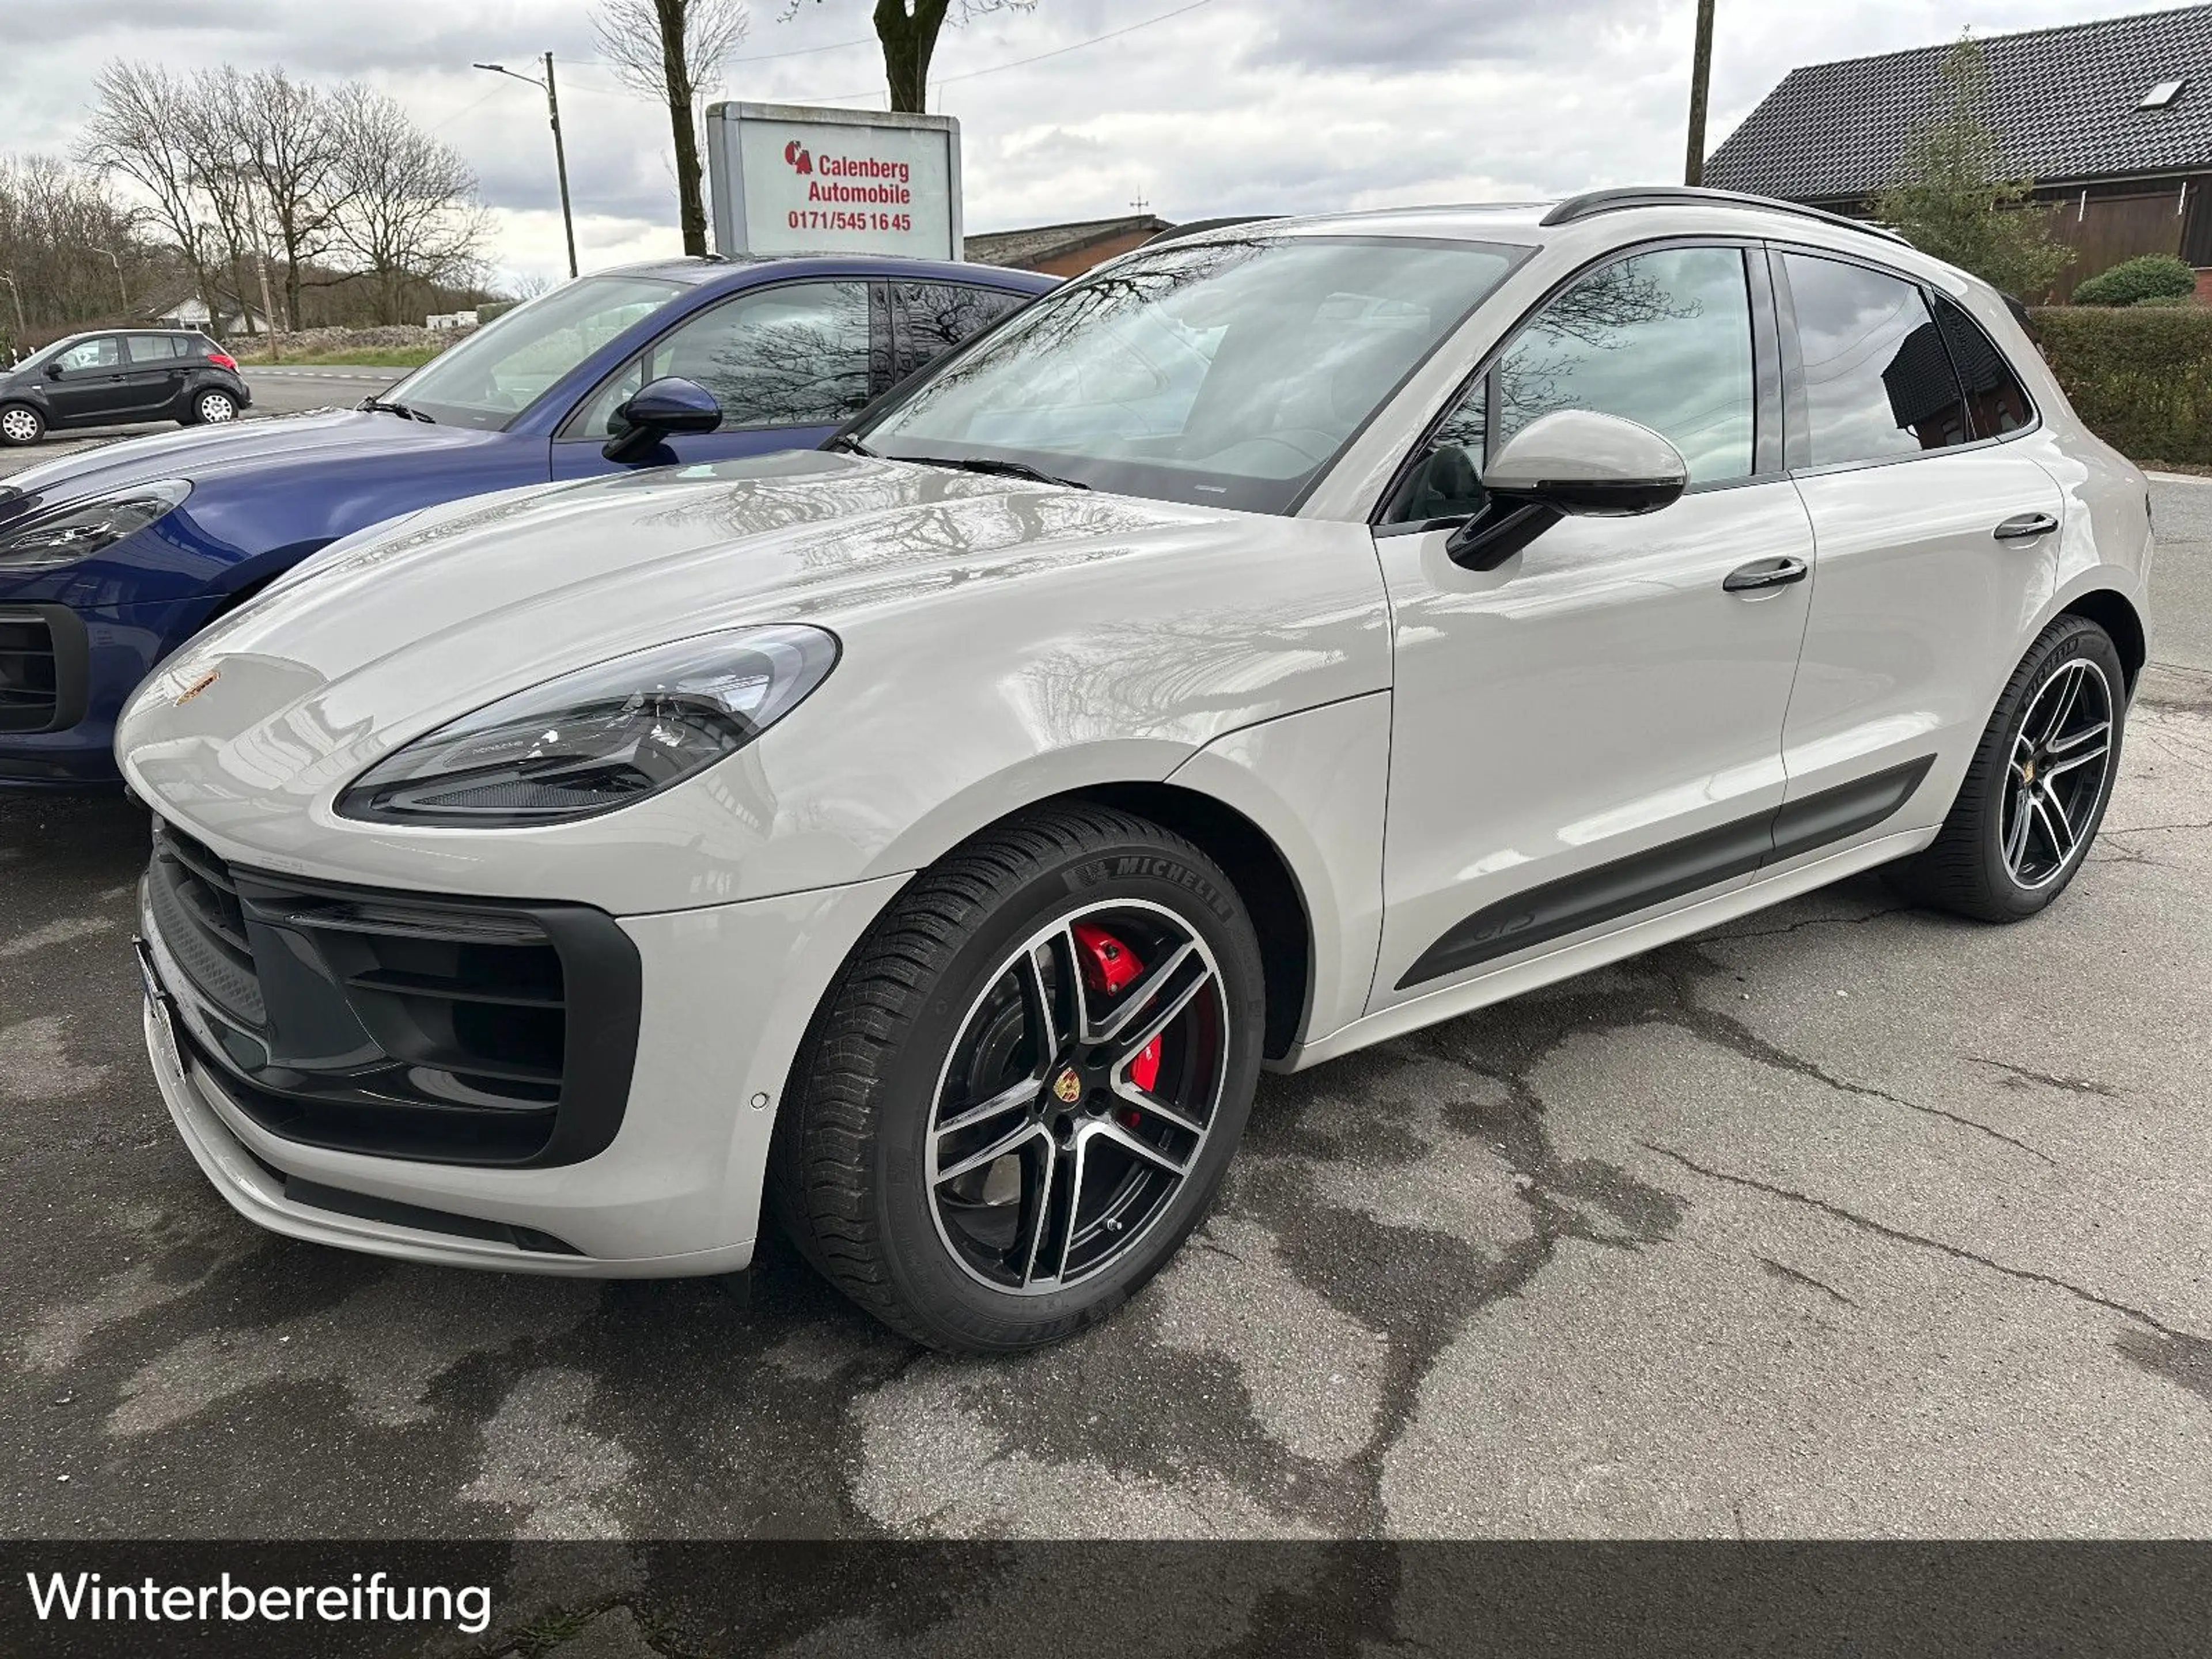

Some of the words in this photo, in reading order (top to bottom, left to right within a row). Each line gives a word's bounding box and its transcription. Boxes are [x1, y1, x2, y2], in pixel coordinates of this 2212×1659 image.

[819, 154, 909, 183] Calenberg
[809, 181, 910, 204] Automobile
[788, 210, 866, 230] 0171/545
[1116, 857, 1230, 915] MICHELIN
